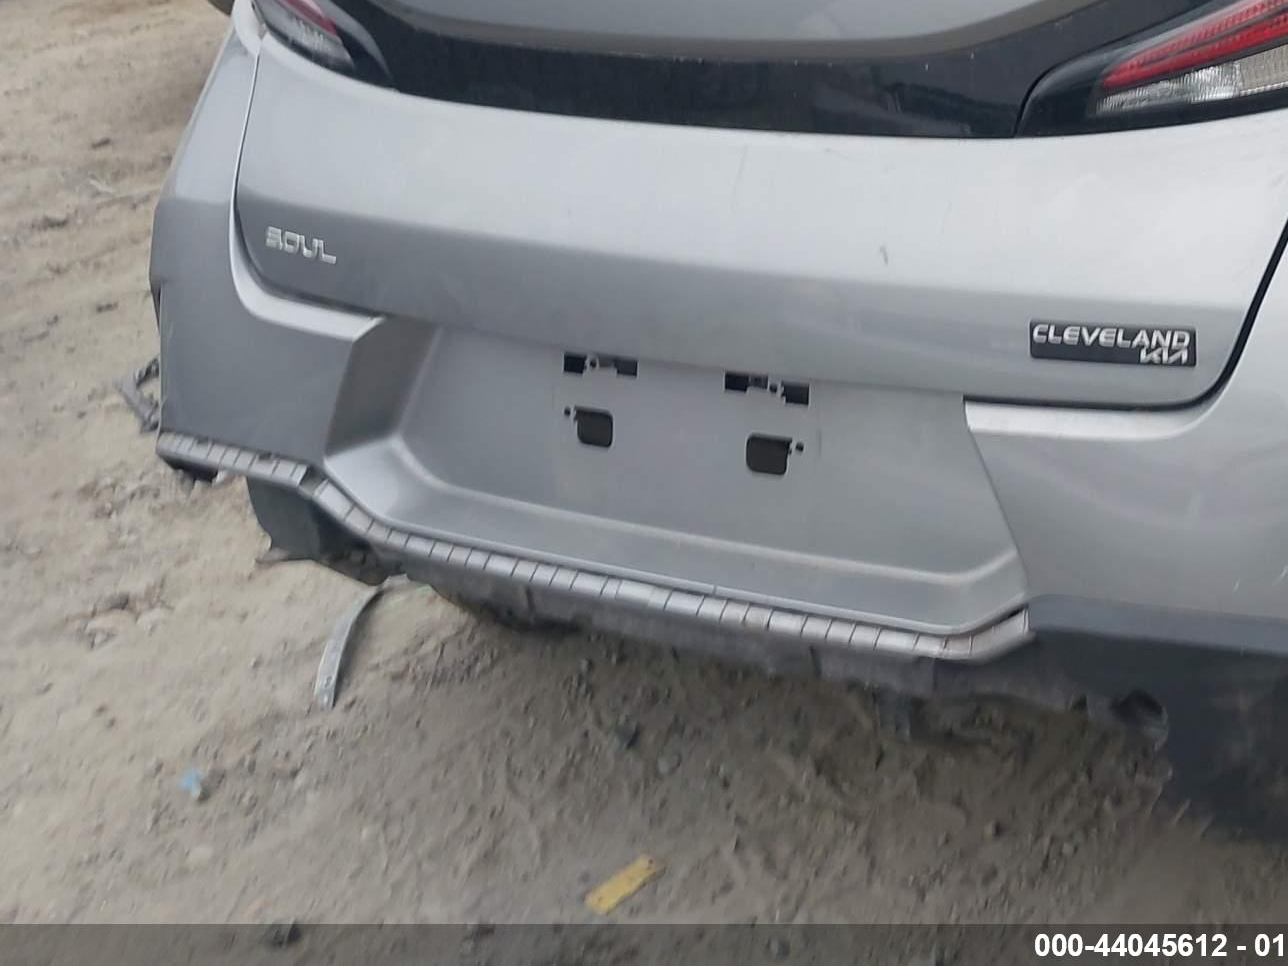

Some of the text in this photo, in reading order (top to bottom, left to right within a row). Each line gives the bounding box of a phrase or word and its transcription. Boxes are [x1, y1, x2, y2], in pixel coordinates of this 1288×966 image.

[265, 225, 337, 265] SOUL
[1032, 323, 1191, 350] CLEVELAND
[1139, 346, 1189, 365] KIA
